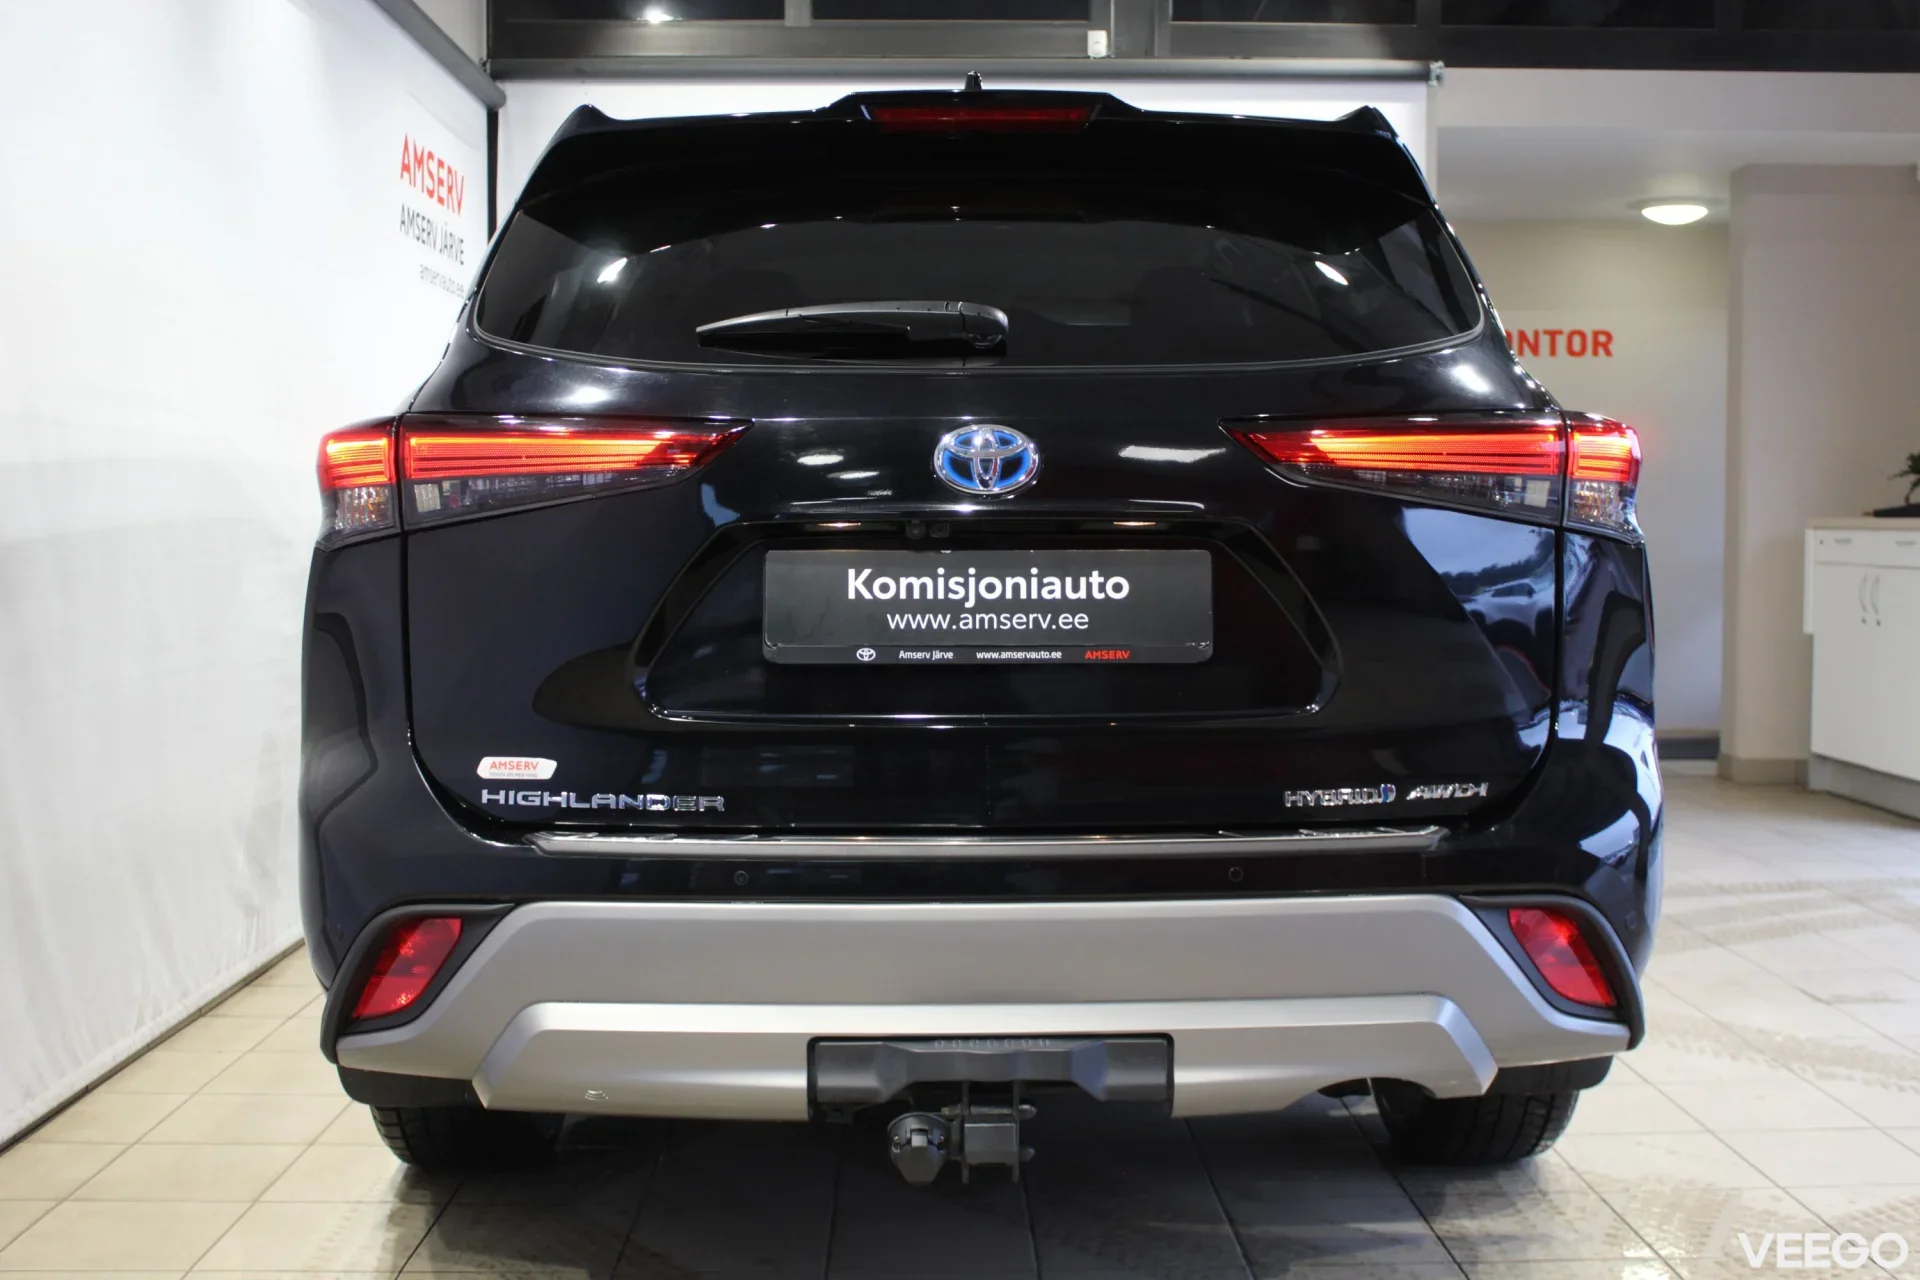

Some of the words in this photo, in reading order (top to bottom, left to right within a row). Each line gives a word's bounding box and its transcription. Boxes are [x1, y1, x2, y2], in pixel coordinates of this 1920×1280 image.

[400, 133, 465, 216] AMSERV
[400, 203, 438, 251] AMSERV
[439, 221, 464, 265] JÄRVE
[847, 568, 1130, 608] Komisjoniauto
[887, 611, 1090, 630] www.amserv.ee
[899, 650, 931, 660] Amserv
[932, 650, 954, 661] Järve
[976, 650, 1062, 660] www.amservauto.ee
[1085, 650, 1130, 660] AMSERV
[489, 760, 539, 771] AMSERV
[481, 788, 725, 812] HIGHLANDER
[1284, 788, 1381, 807] HYBRID
